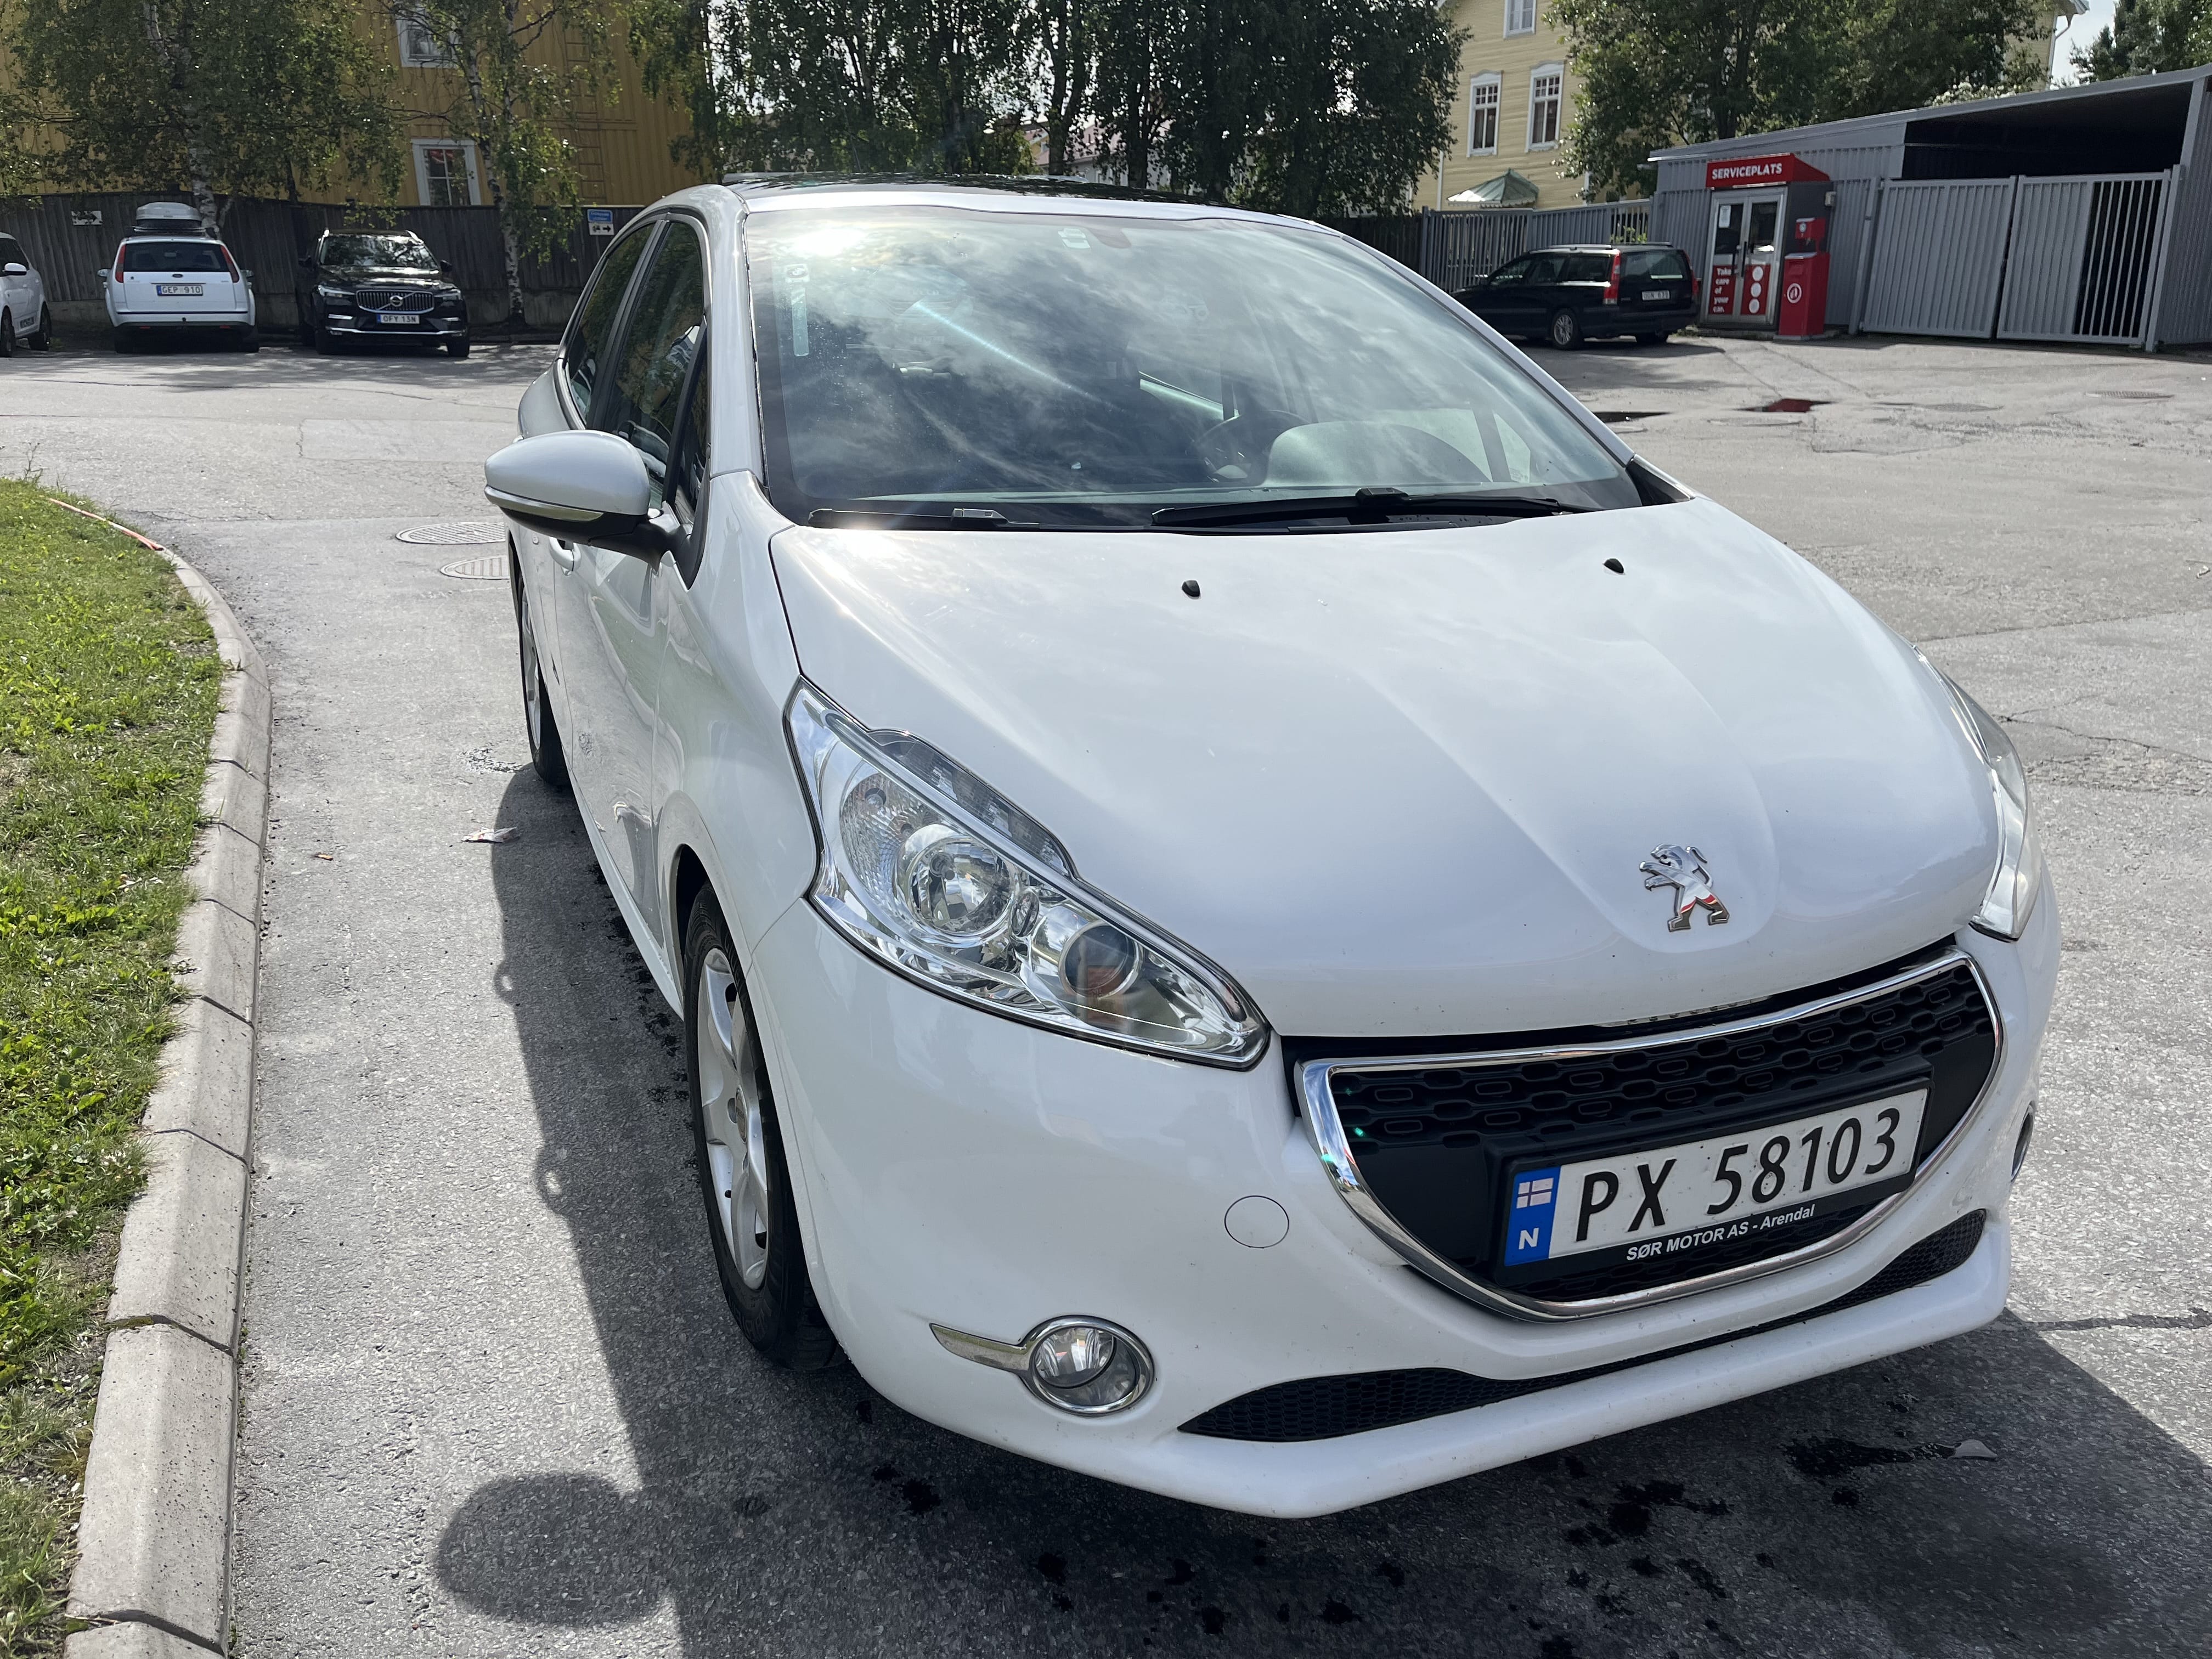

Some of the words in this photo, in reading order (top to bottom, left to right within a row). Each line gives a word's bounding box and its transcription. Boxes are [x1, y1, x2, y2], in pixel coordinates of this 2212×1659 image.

[1712, 163, 1782, 180] SERVICEPLATS
[1576, 1159, 1677, 1242] PX
[1706, 1108, 1900, 1215] 58103
[1518, 1227, 1539, 1250] N
[1626, 1242, 1663, 1261] SØR
[1666, 1227, 1725, 1252] MOTOR
[1726, 1221, 1749, 1238] AS
[1759, 1204, 1815, 1230] Arendal
